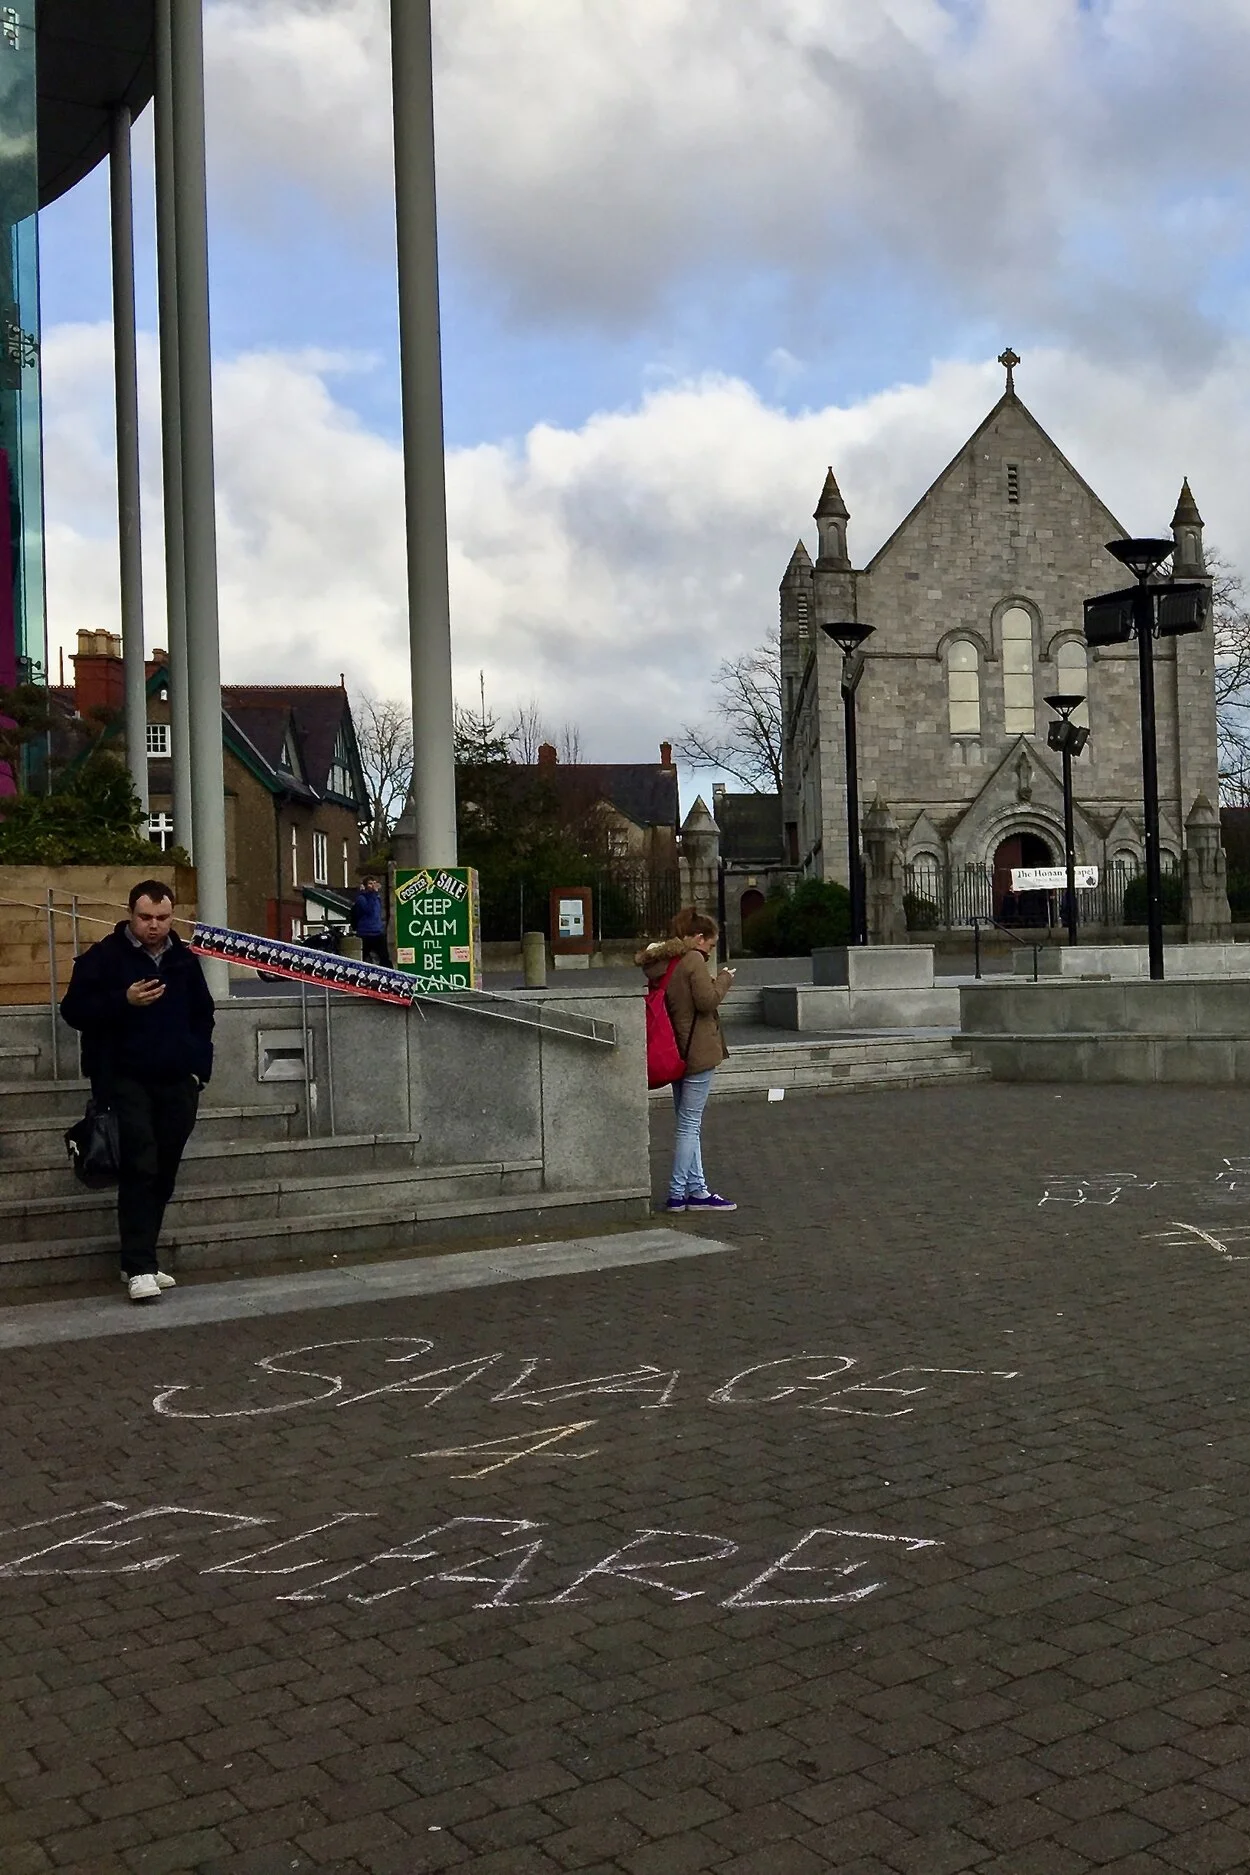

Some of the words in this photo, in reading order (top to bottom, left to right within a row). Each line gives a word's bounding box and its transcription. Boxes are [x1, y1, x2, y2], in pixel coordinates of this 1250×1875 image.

[1017, 870, 1031, 878] The
[1034, 869, 1063, 877] Honan
[400, 877, 428, 900] POSTER
[436, 872, 465, 899] SALE
[412, 898, 452, 916] KEEP
[408, 919, 456, 936] CALM
[424, 953, 443, 970] BE
[152, 1336, 1020, 1419] SAVAGE
[406, 1419, 599, 1479] 4
[0, 1500, 946, 1609] ELFARE
